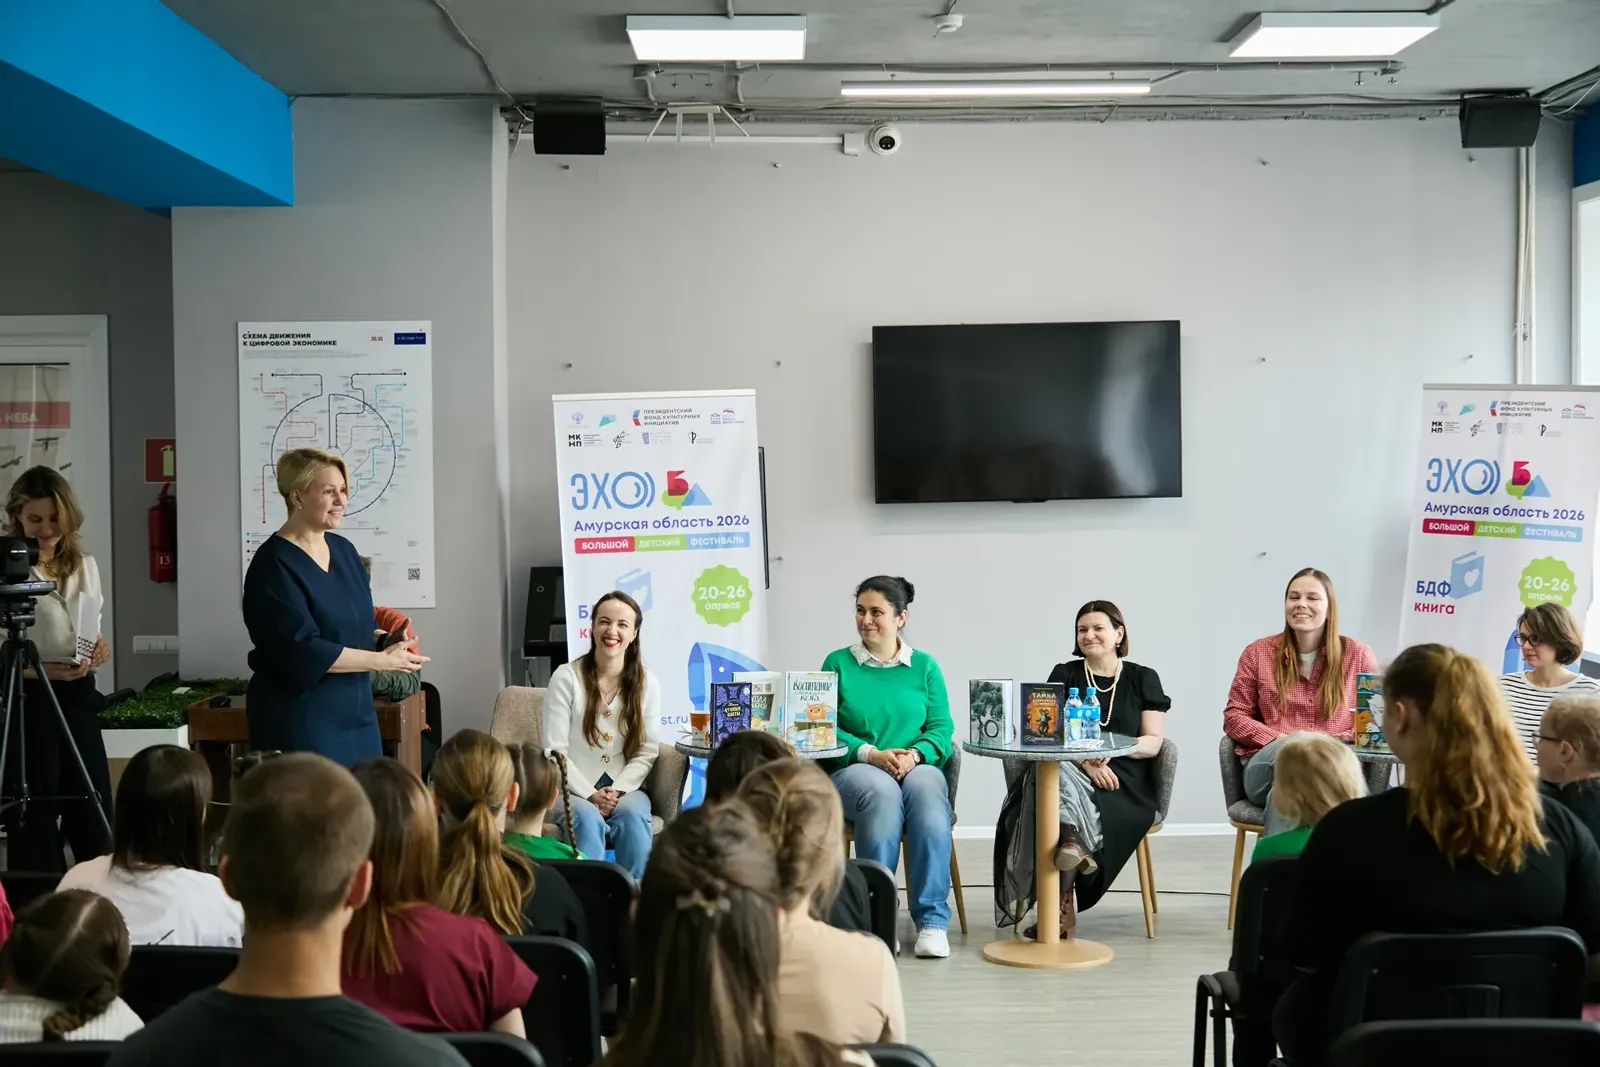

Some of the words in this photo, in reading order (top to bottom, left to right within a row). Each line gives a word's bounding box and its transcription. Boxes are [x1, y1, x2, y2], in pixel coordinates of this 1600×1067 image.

[249, 340, 291, 348] ЦИФРОВОЙ
[5, 412, 38, 423] НЕБА
[1424, 502, 1489, 516] Амурская
[1493, 504, 1549, 519] область
[1552, 508, 1585, 521] 2026
[574, 518, 649, 534] Амурская
[652, 516, 713, 529] область
[716, 515, 750, 527] 2026
[1428, 522, 1470, 532] БОЛЬШОЙ
[1477, 524, 1517, 535] ДЕТСКИЙ
[1524, 527, 1577, 539] ФЕСТИВАЛЬ
[581, 539, 629, 550] БОЛЬШОЙ
[638, 537, 681, 549] ДЕТСКИЙ
[690, 536, 745, 547] ФЕСТИВАЛЬ
[159, 555, 171, 566] 13
[1416, 580, 1451, 598] БДФ
[1523, 575, 1571, 592] 20-26
[698, 585, 746, 600] 20-26
[1527, 592, 1564, 602] апреля
[704, 601, 741, 612] апреля
[1414, 602, 1455, 615] книга
[1032, 691, 1057, 699] ТАЙНА
[660, 715, 688, 726] st.ru
